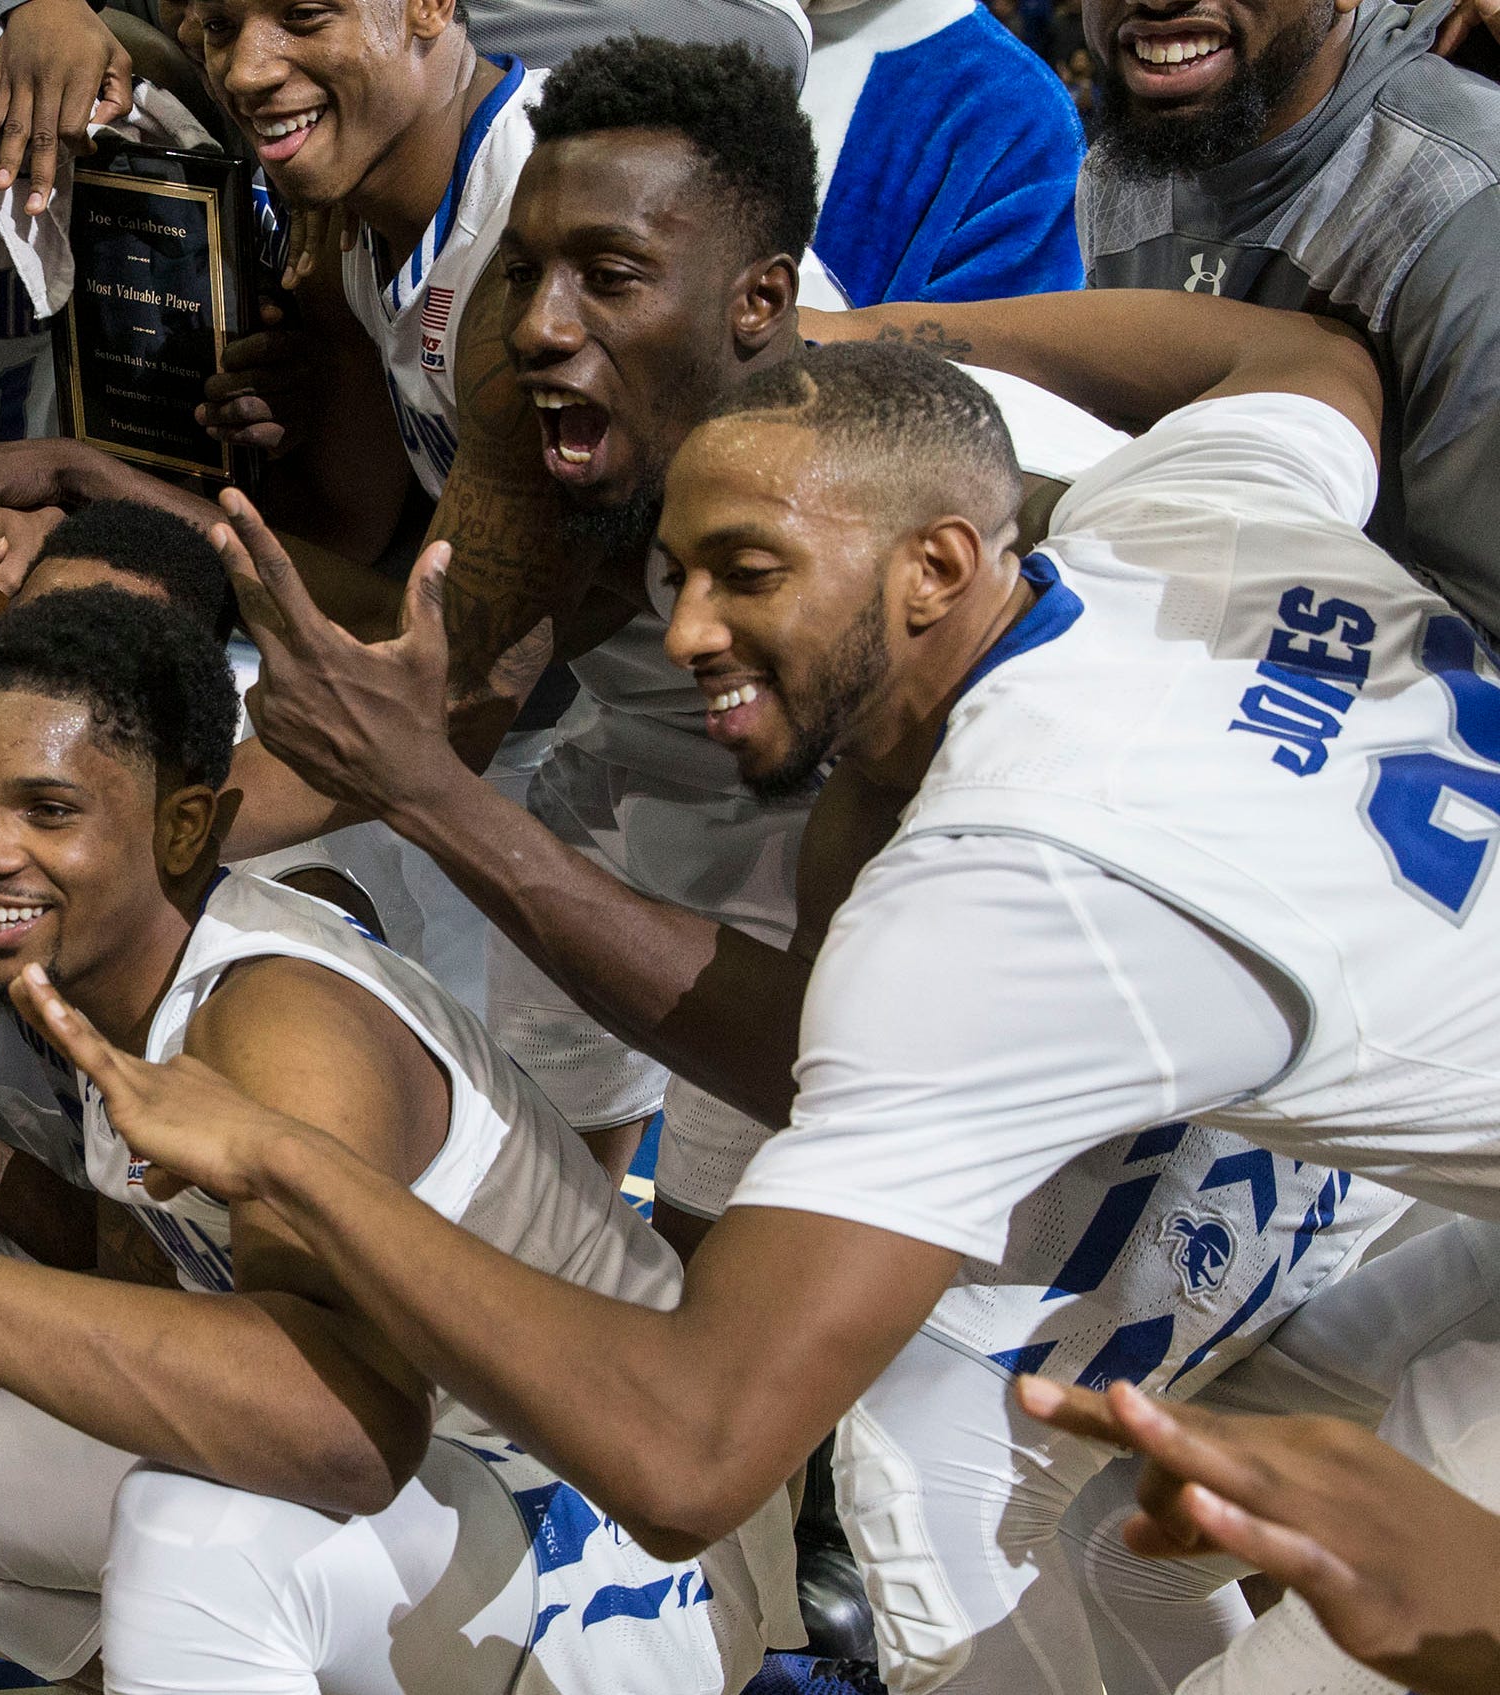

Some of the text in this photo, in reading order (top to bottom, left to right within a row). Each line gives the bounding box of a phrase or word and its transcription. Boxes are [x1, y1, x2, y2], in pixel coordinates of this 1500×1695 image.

[88, 210, 188, 239] Joe Calabrese
[86, 277, 201, 313] Most Valuable Player
[123, 353, 143, 368] Hall
[1226, 584, 1377, 778] JONES
